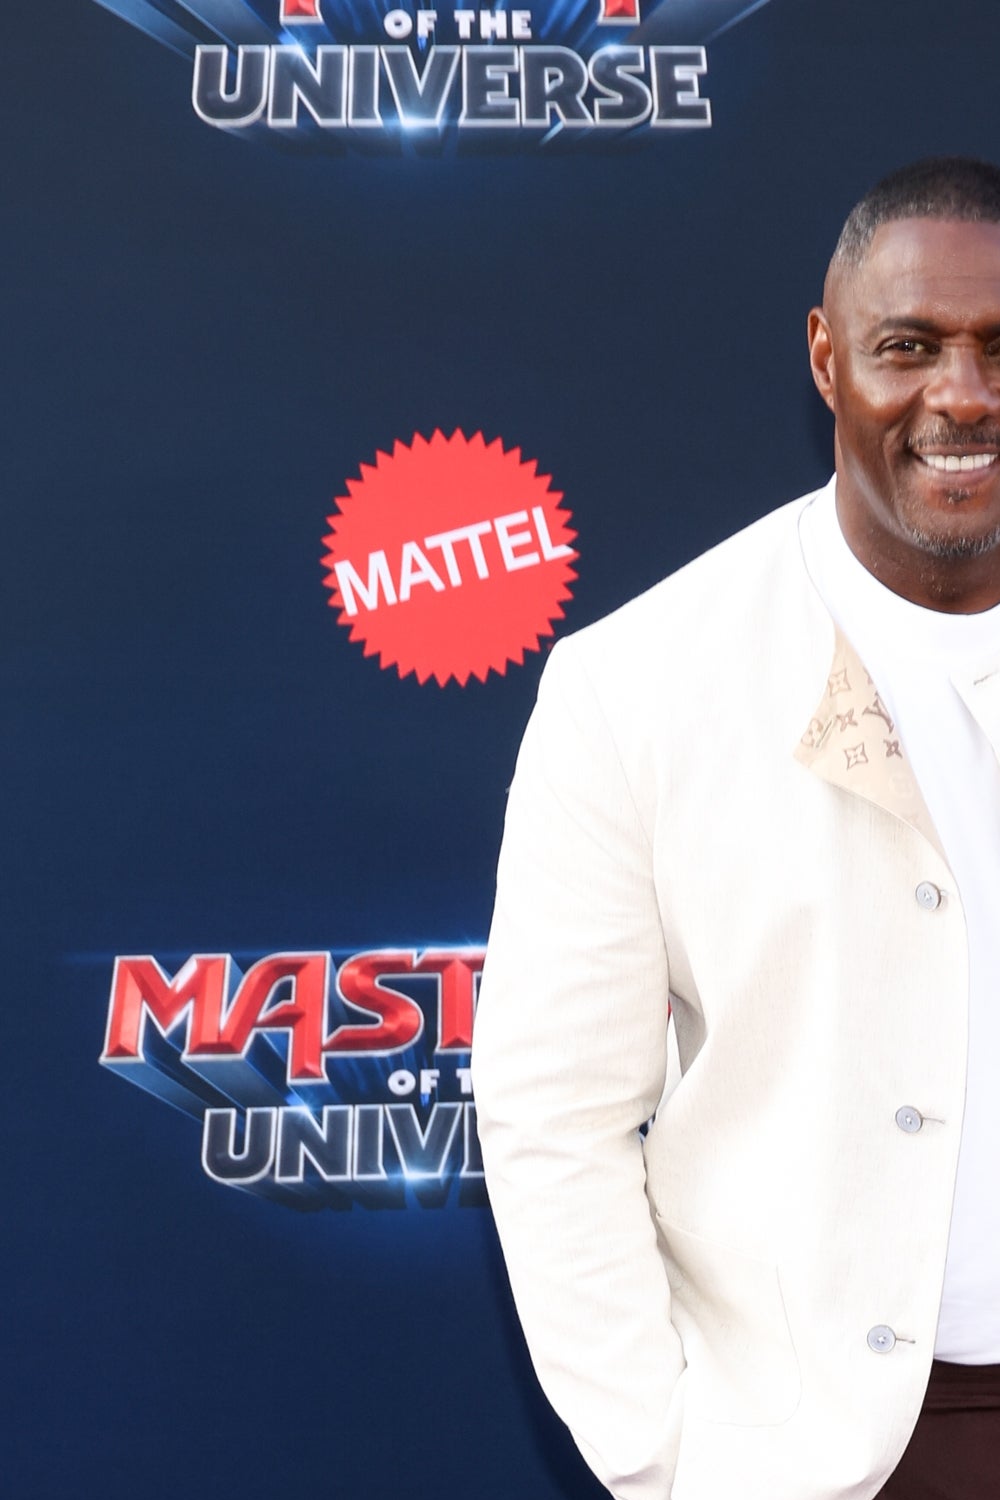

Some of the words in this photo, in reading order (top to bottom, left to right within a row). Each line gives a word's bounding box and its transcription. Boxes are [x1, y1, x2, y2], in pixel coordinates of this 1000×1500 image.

[383, 9, 438, 39] OF
[454, 9, 532, 39] THE
[192, 45, 712, 128] UNIVERSE
[333, 505, 574, 617] MATTEL
[99, 949, 488, 1086] MAST
[388, 1069, 440, 1095] OF
[201, 1102, 486, 1184] UNIV
